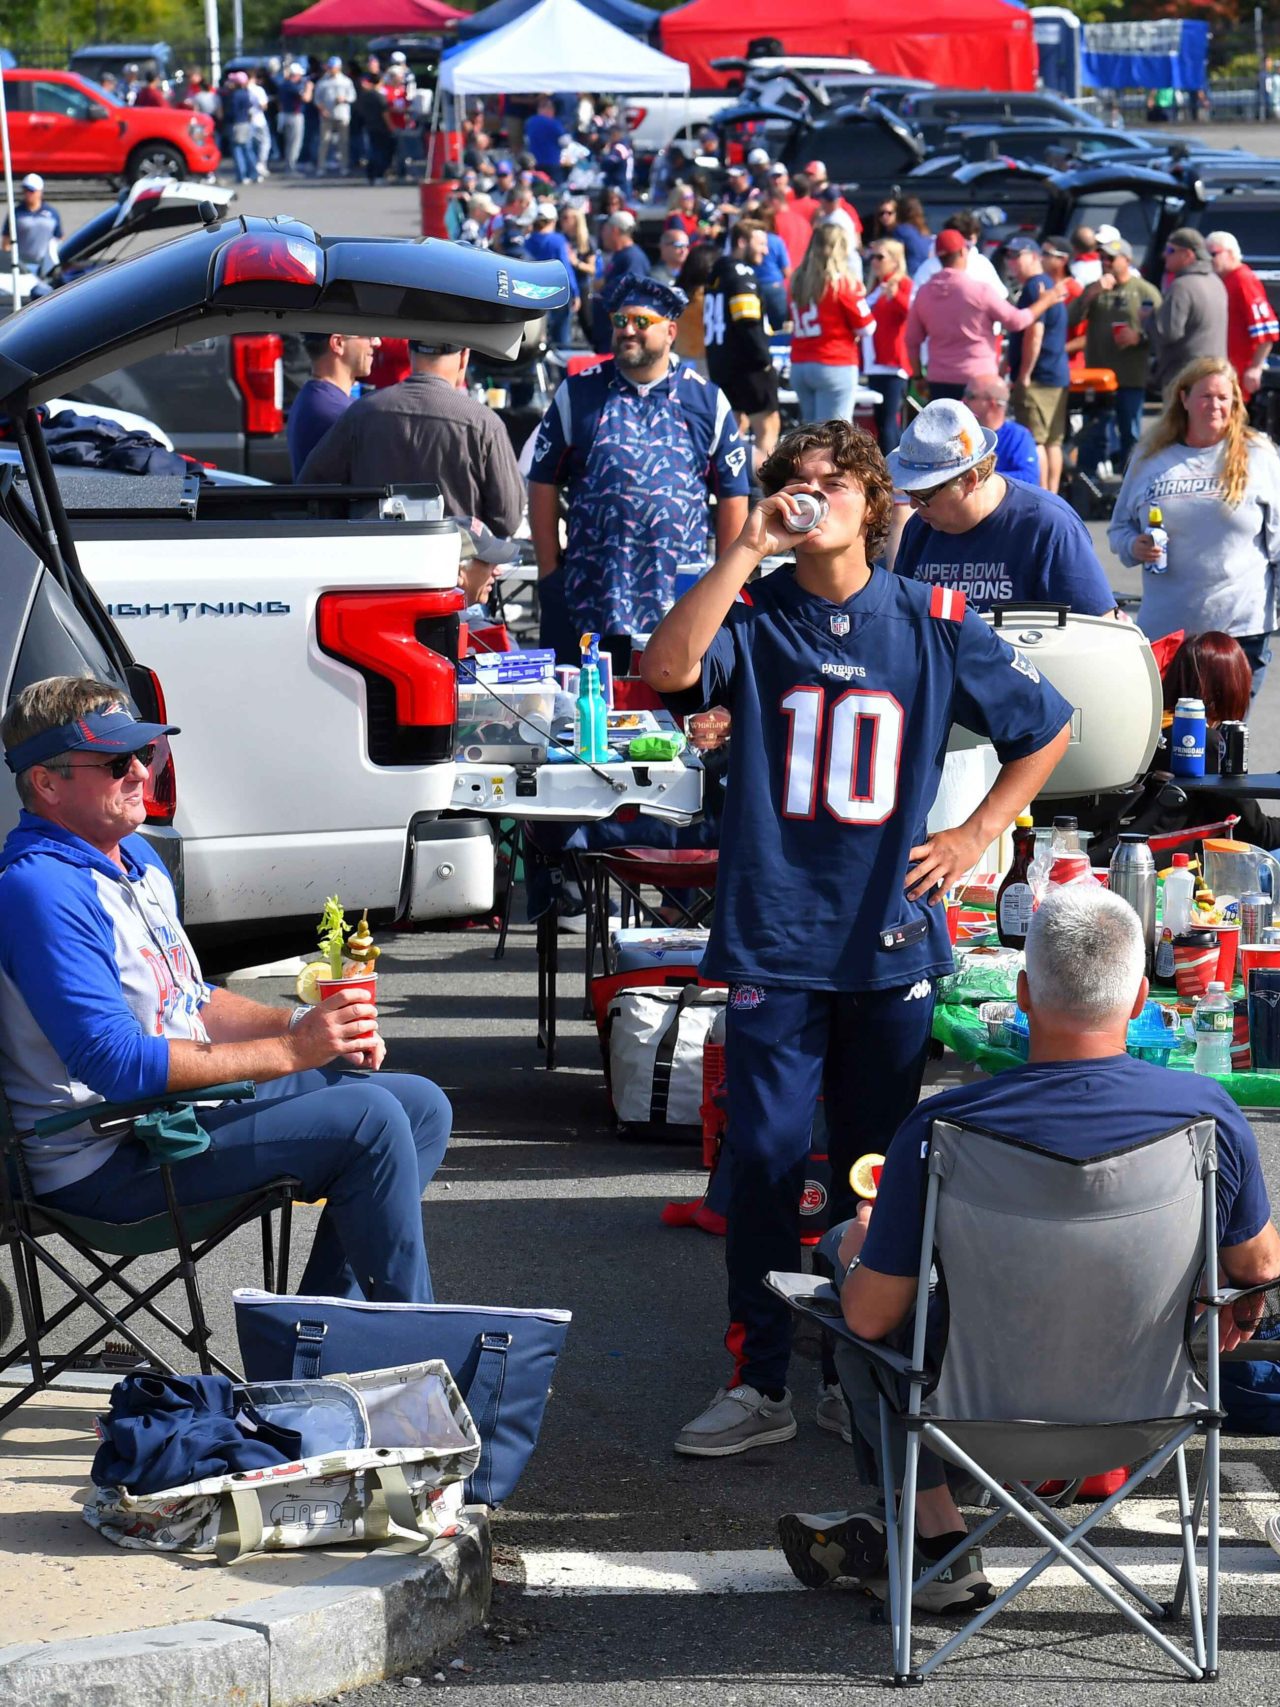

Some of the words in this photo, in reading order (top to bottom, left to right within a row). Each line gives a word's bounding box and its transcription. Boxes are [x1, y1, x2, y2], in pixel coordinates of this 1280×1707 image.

[913, 563, 960, 581] SUPER
[962, 562, 1011, 580] BOWL
[926, 580, 1013, 600] PIONS
[104, 601, 291, 620] IGHTNING
[832, 622, 849, 633] NFL
[821, 663, 867, 678] PATRIOTS
[778, 684, 905, 827] 10
